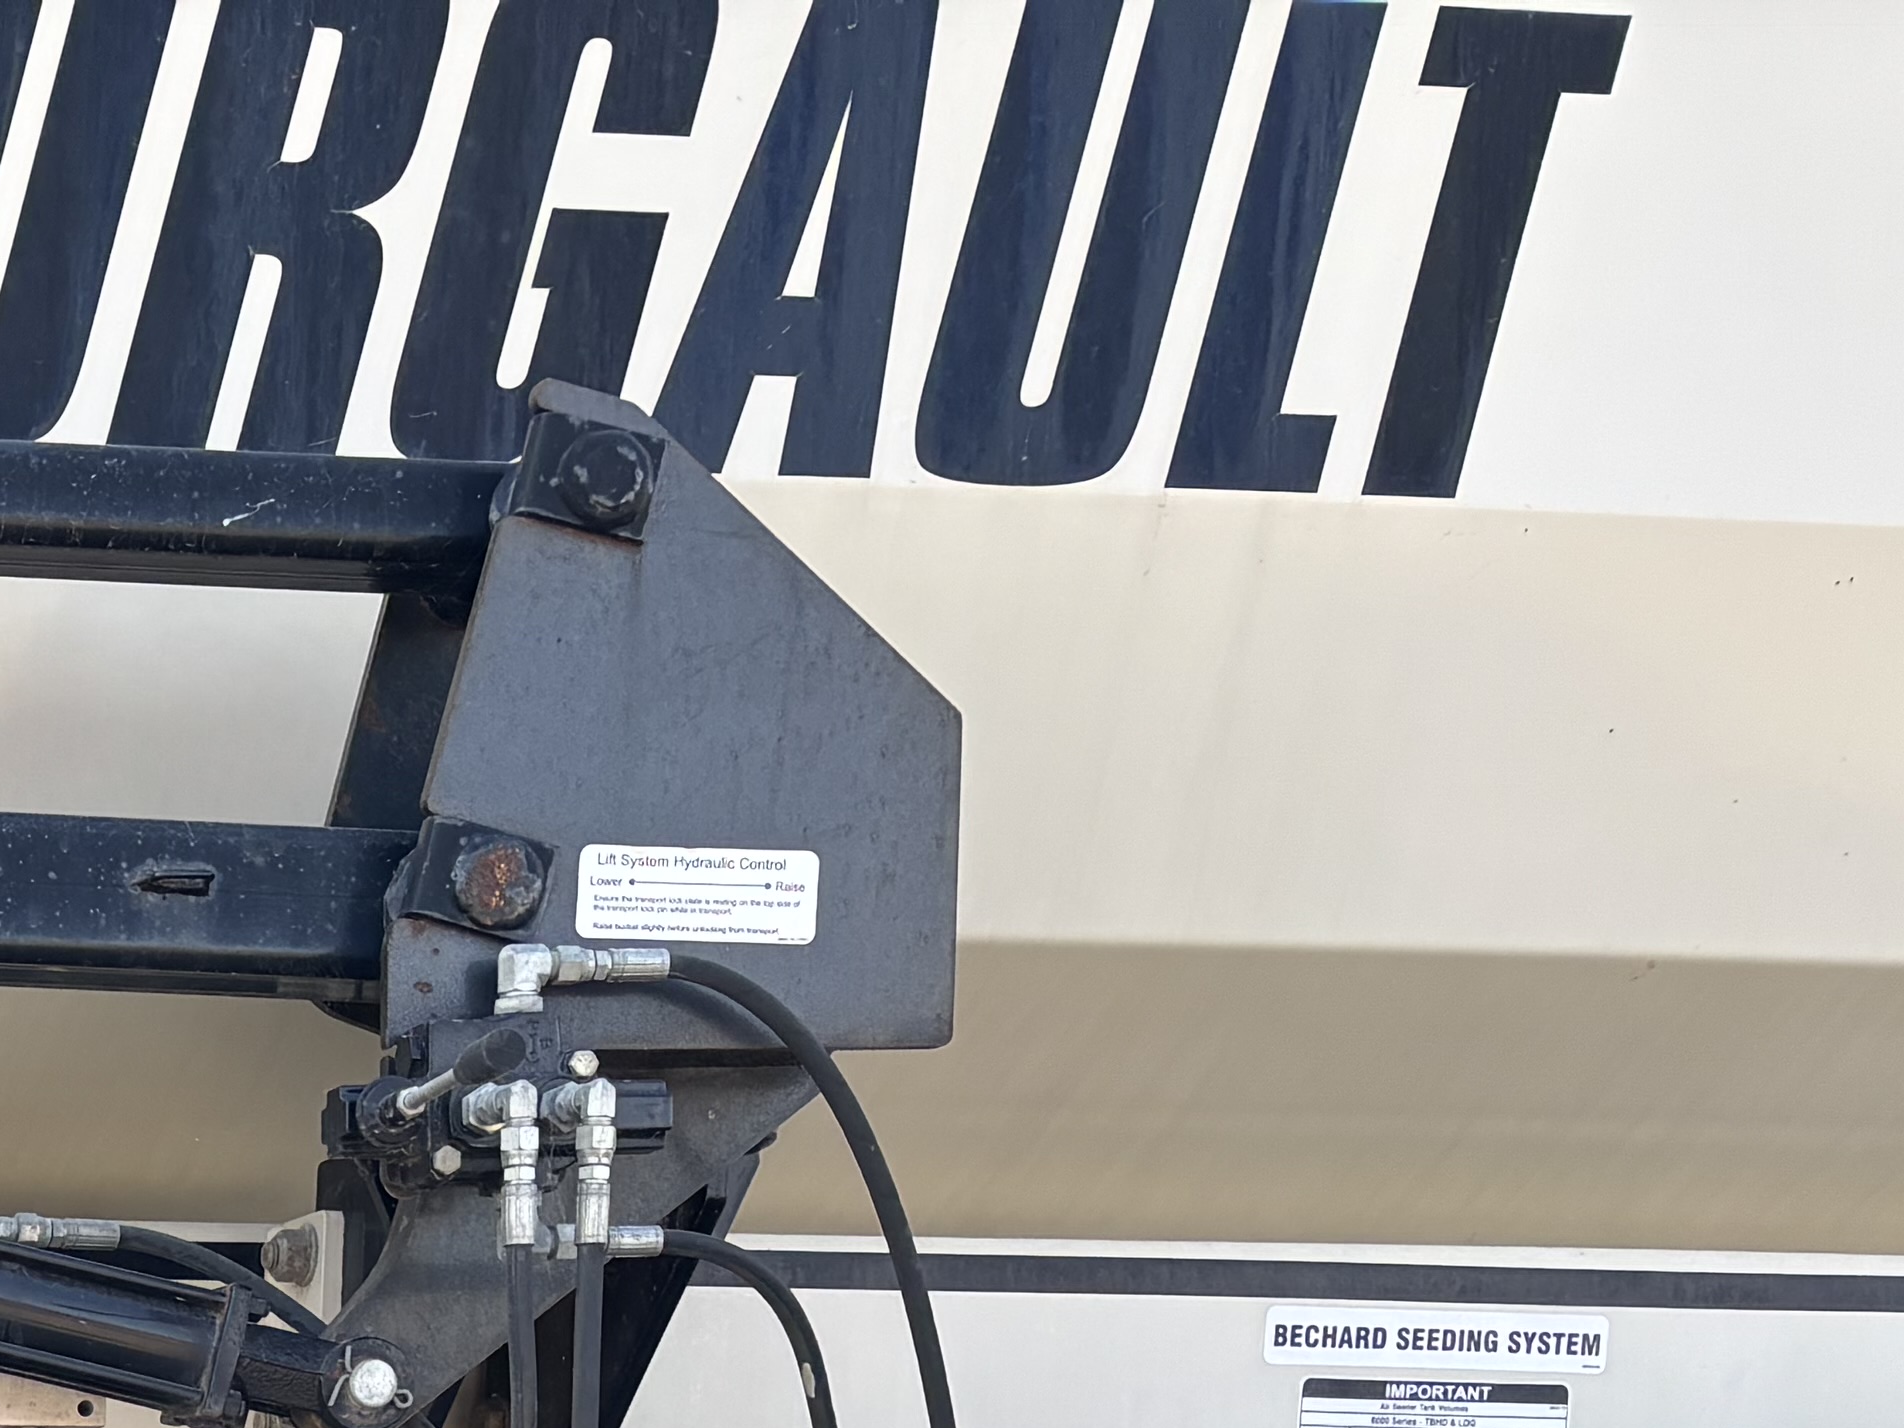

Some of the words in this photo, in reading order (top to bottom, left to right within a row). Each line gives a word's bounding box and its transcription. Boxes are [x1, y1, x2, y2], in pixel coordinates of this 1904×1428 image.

[598, 852, 616, 866] Lift
[621, 853, 669, 870] System
[674, 855, 735, 871] Hydraulic
[739, 857, 787, 871] Control
[590, 875, 622, 886] Lower
[775, 880, 806, 892] Raise
[1273, 1324, 1388, 1350] BECHARD
[1396, 1327, 1499, 1353] SEEDING
[1507, 1330, 1601, 1357] SYSTEM
[1385, 1383, 1492, 1400] IMPORTANT
